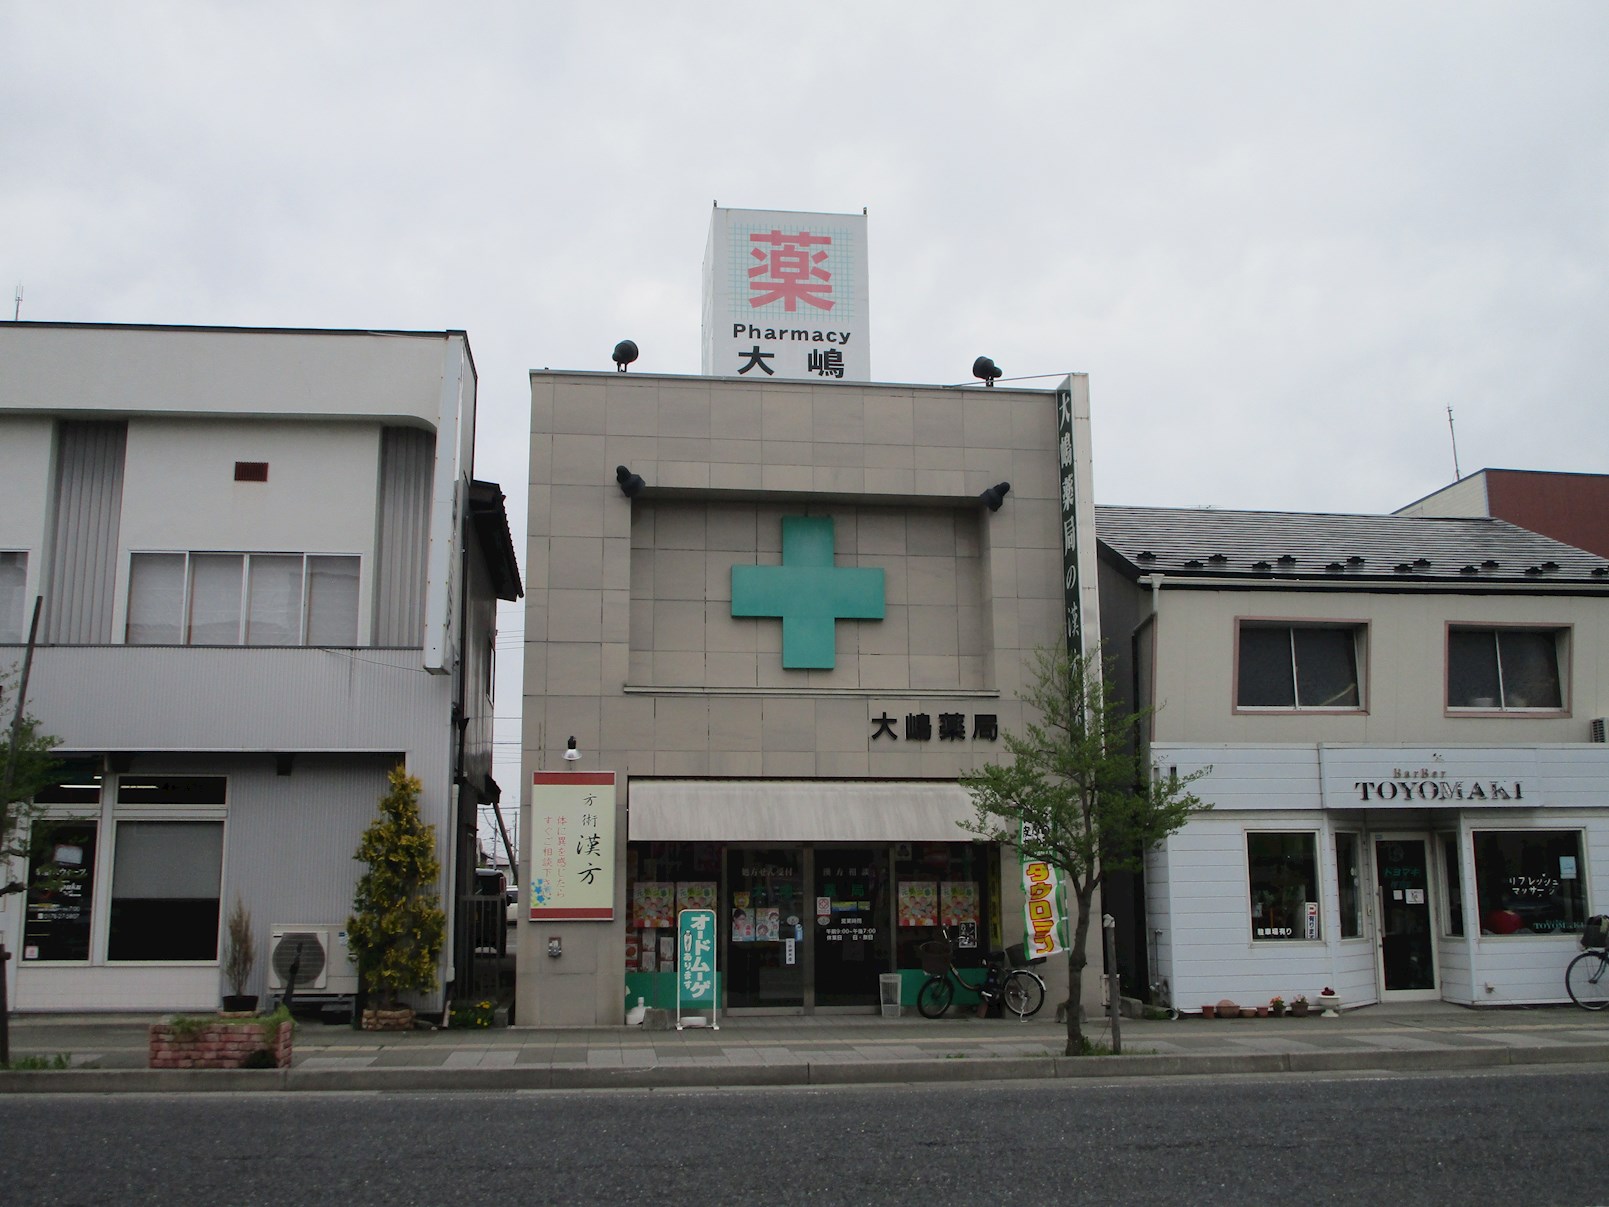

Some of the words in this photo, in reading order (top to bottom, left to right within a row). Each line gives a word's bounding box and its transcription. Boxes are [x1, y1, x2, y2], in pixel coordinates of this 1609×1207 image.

[747, 230, 836, 312] 薬
[733, 323, 851, 345] Pharmacy
[737, 345, 845, 379] 大嶋
[871, 712, 999, 742] 大嶋薬局
[1354, 780, 1524, 801] TOYOMAKI
[683, 952, 692, 990] あります
[690, 914, 711, 998] オードムーゲ
